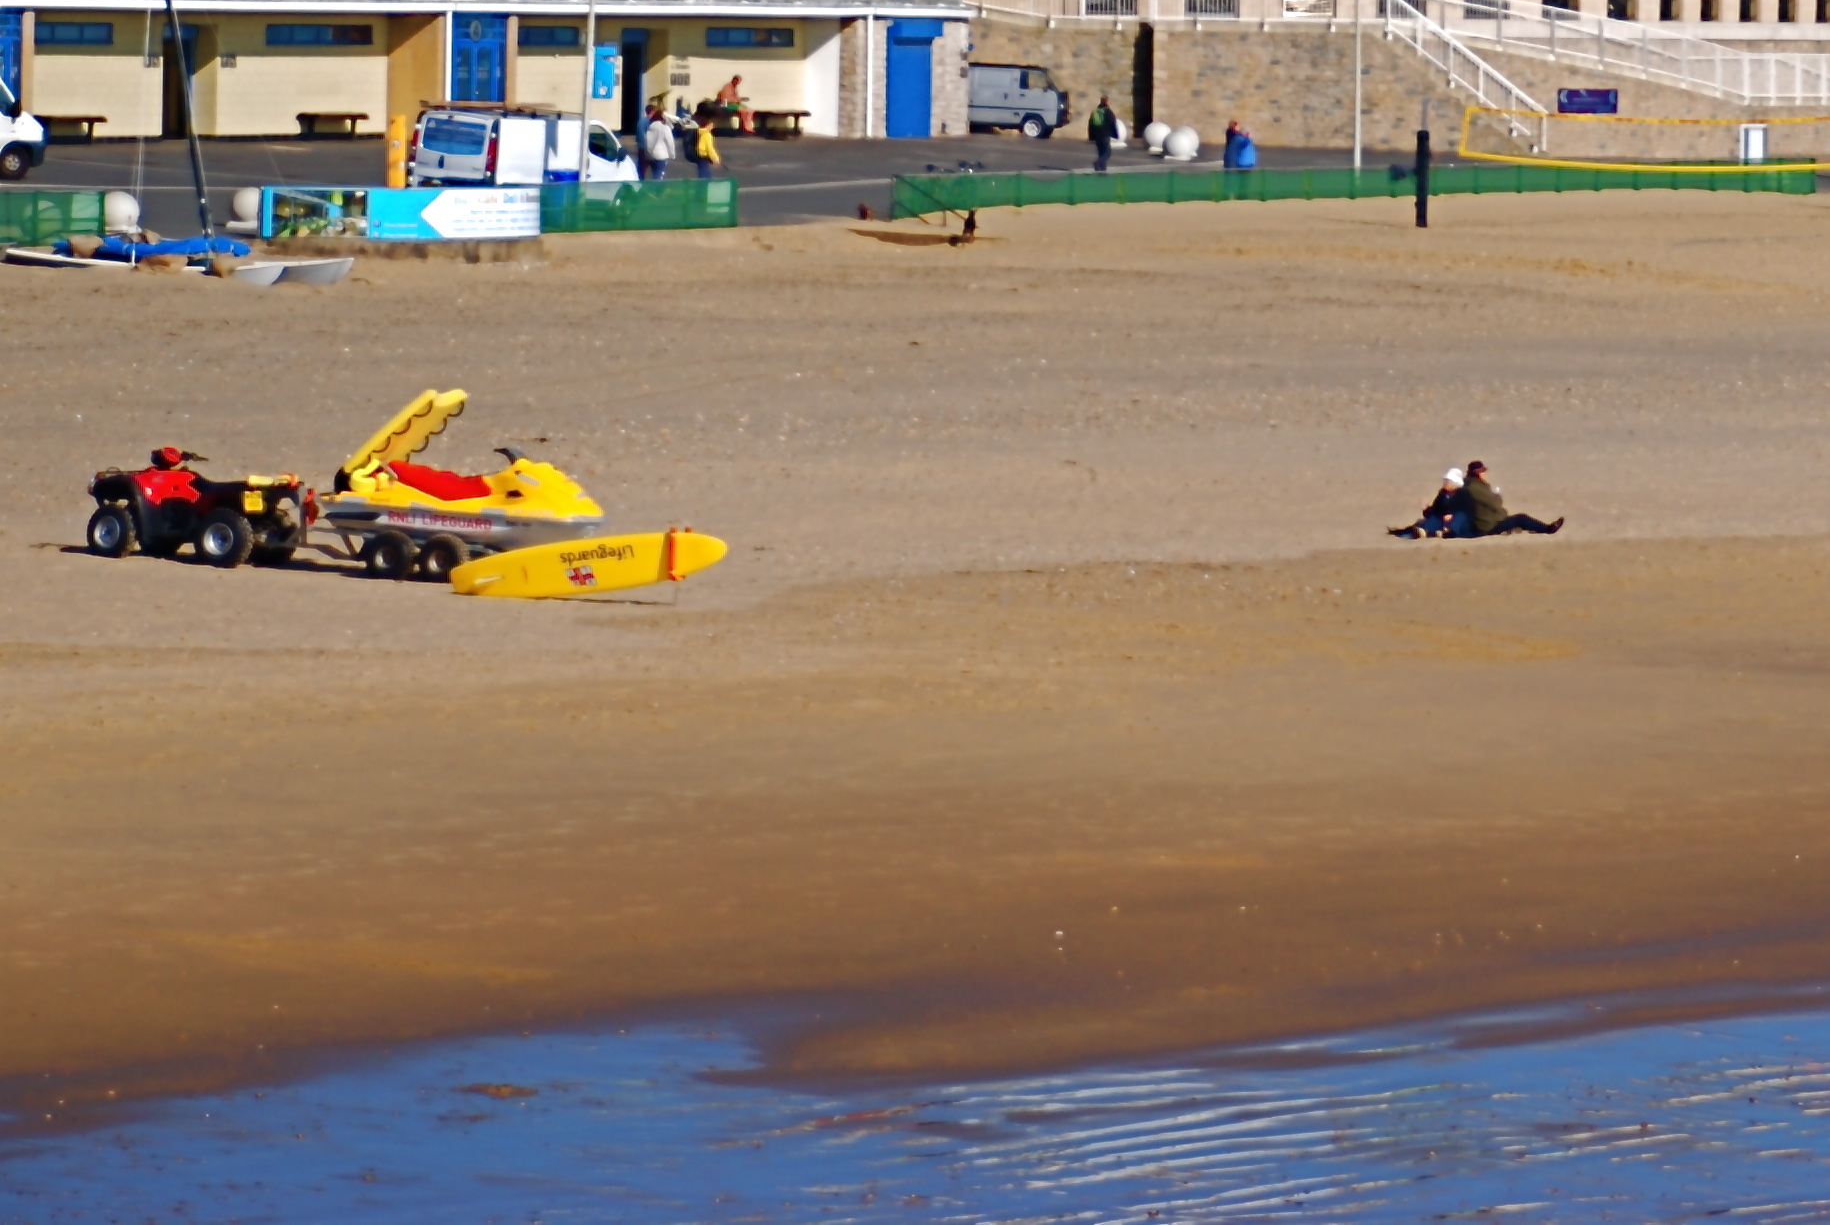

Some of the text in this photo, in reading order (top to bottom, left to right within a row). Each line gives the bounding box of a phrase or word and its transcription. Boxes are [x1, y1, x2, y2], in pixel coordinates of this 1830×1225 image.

[387, 510, 416, 525] RNLI
[421, 513, 492, 531] LIFEGUARD
[559, 543, 635, 566] Lifeguards
